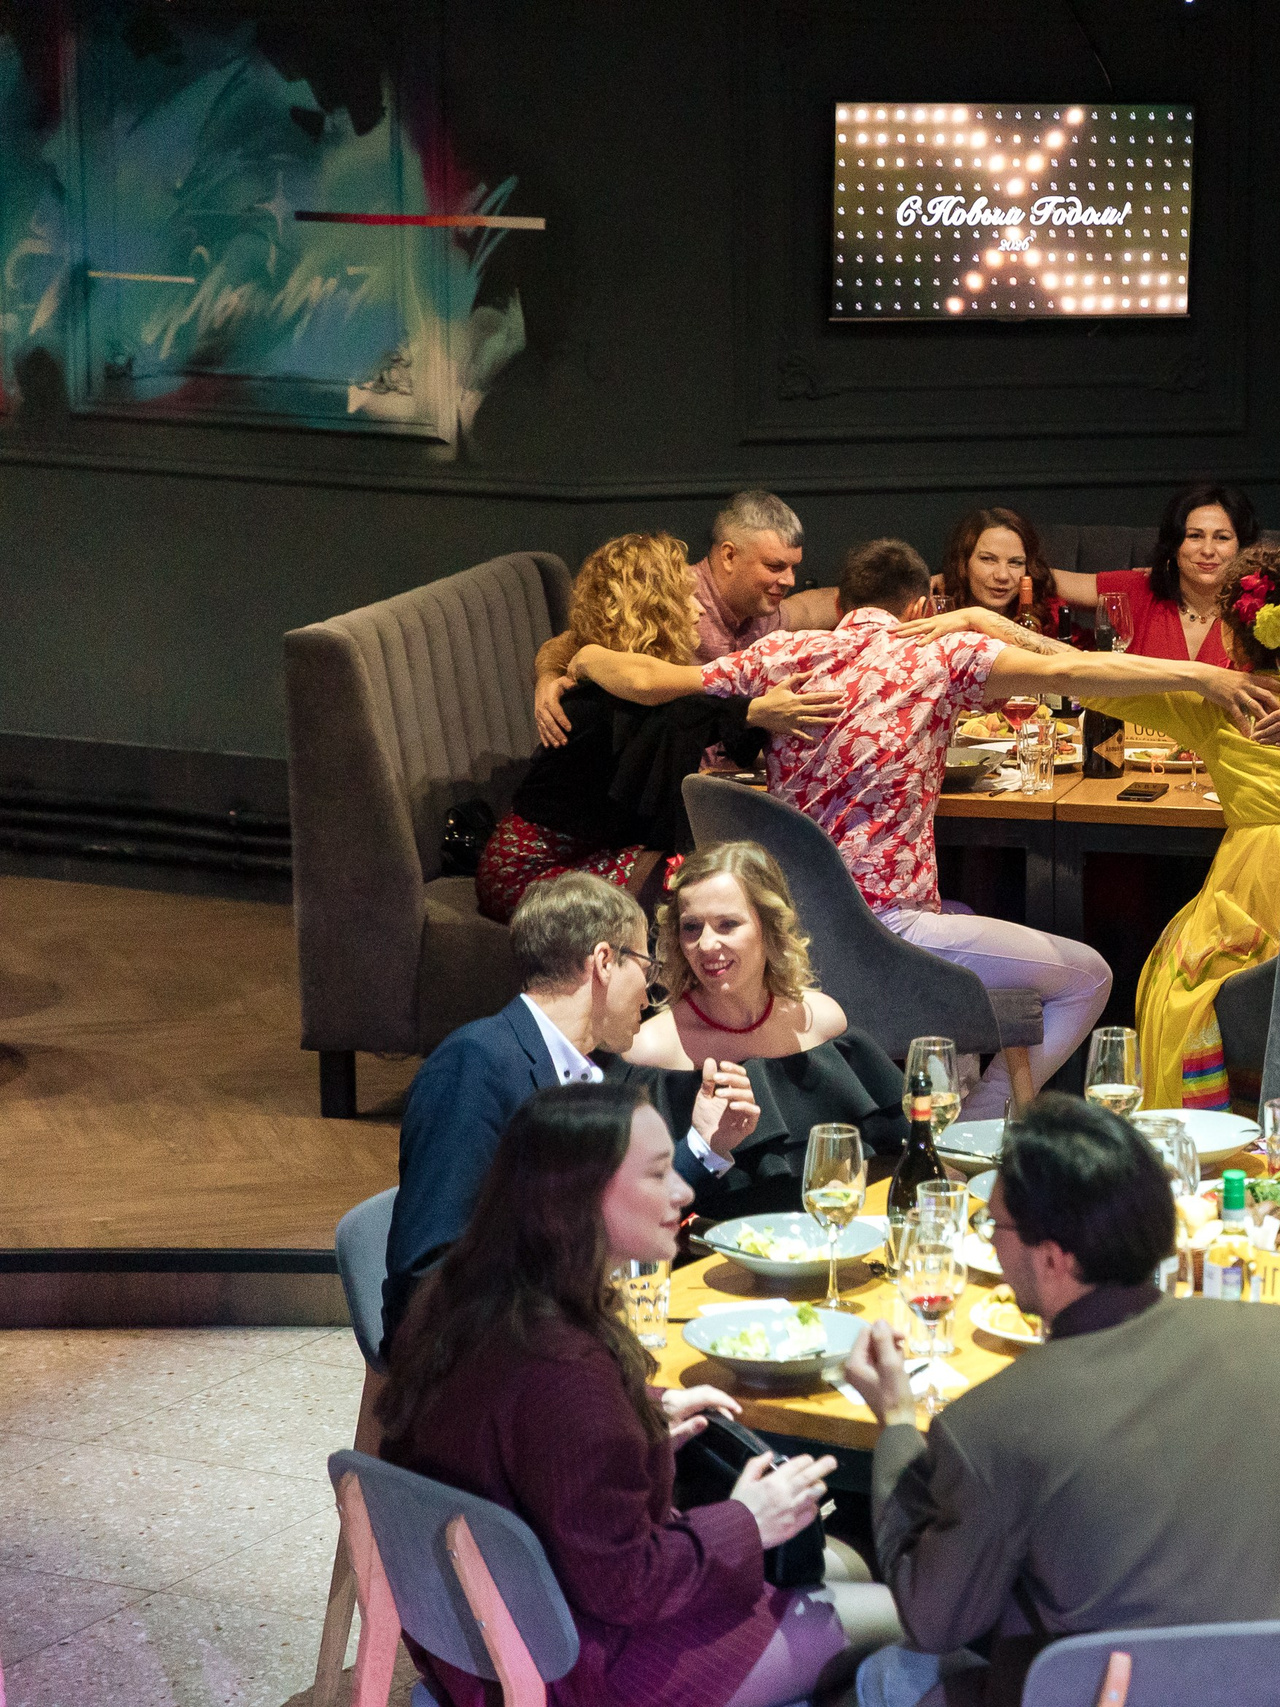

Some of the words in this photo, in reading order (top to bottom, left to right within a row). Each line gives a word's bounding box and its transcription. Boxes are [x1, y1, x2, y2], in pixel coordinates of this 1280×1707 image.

[896, 195, 923, 227] С
[921, 195, 1026, 227] Новым
[1029, 195, 1132, 226] Годом!
[998, 236, 1035, 252] 2026
